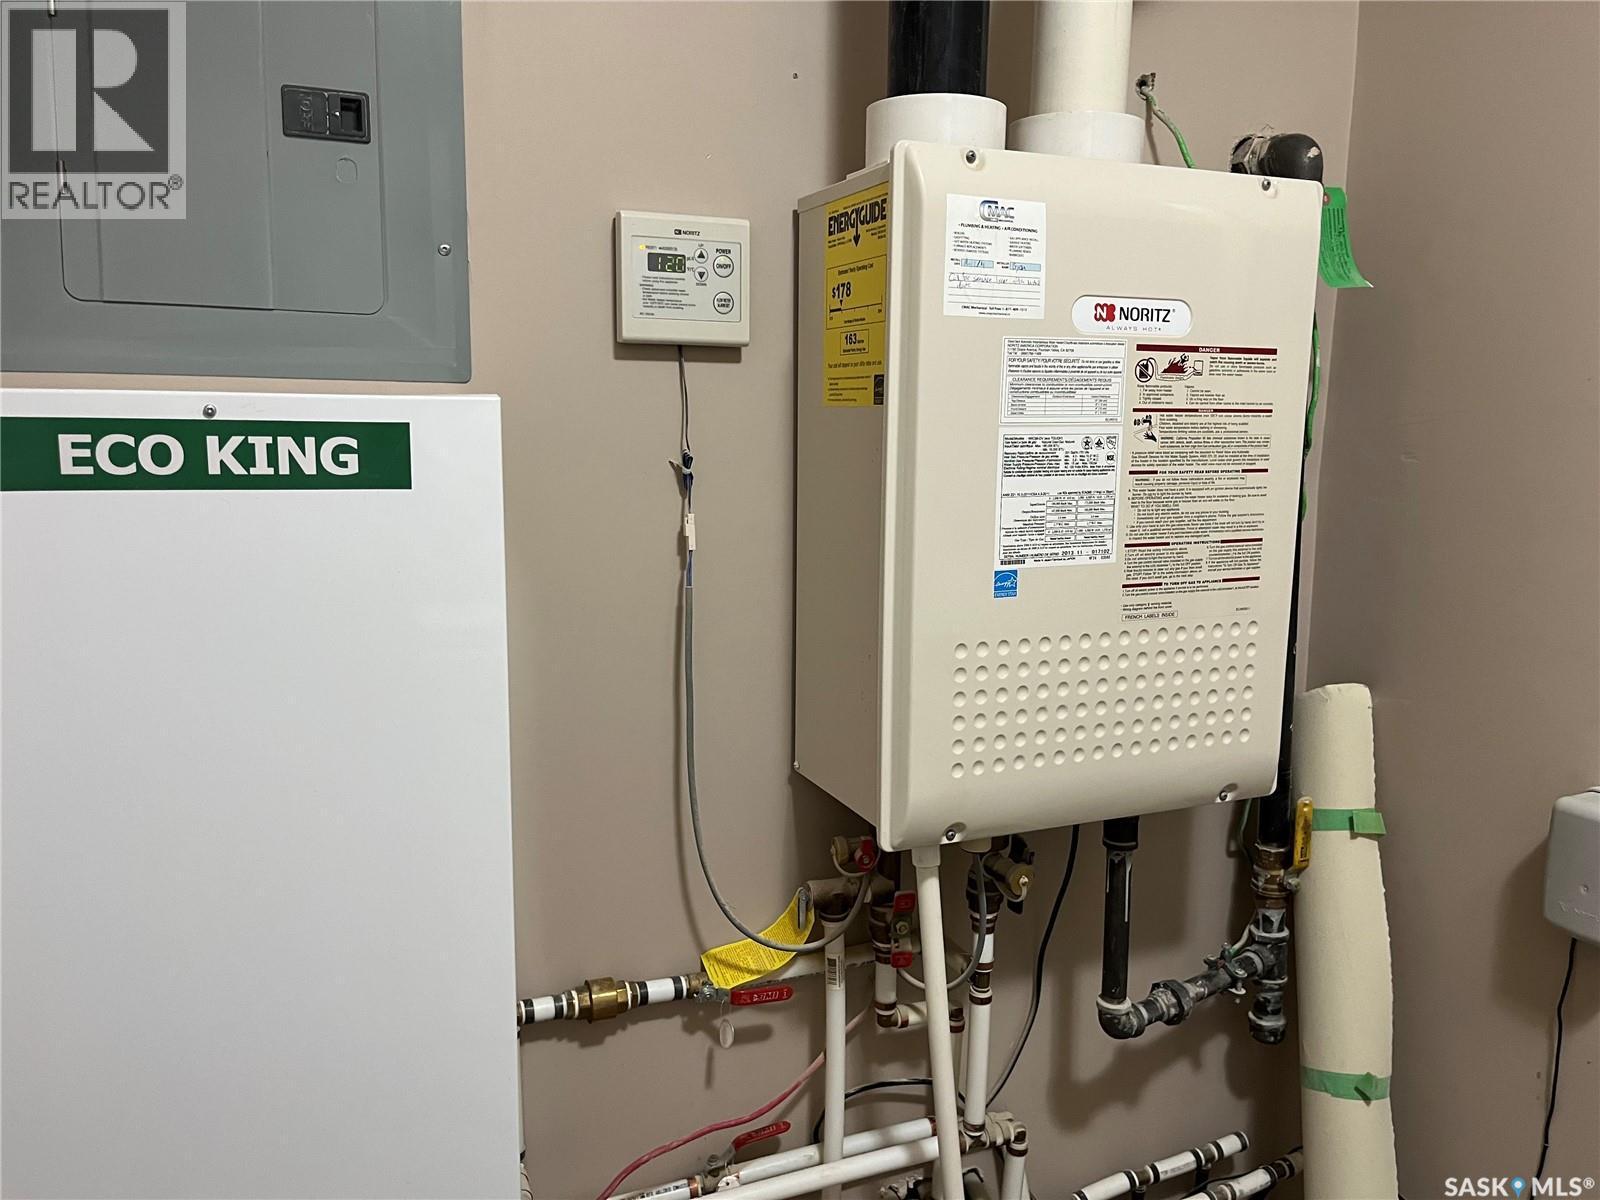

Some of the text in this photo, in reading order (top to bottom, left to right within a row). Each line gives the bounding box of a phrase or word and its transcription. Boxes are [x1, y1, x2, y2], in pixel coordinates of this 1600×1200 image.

[658, 256, 684, 272] 120
[832, 282, 851, 298] $178
[1119, 306, 1170, 322] NORITZ
[845, 333, 857, 345] 163
[57, 433, 359, 475] ECO KING
